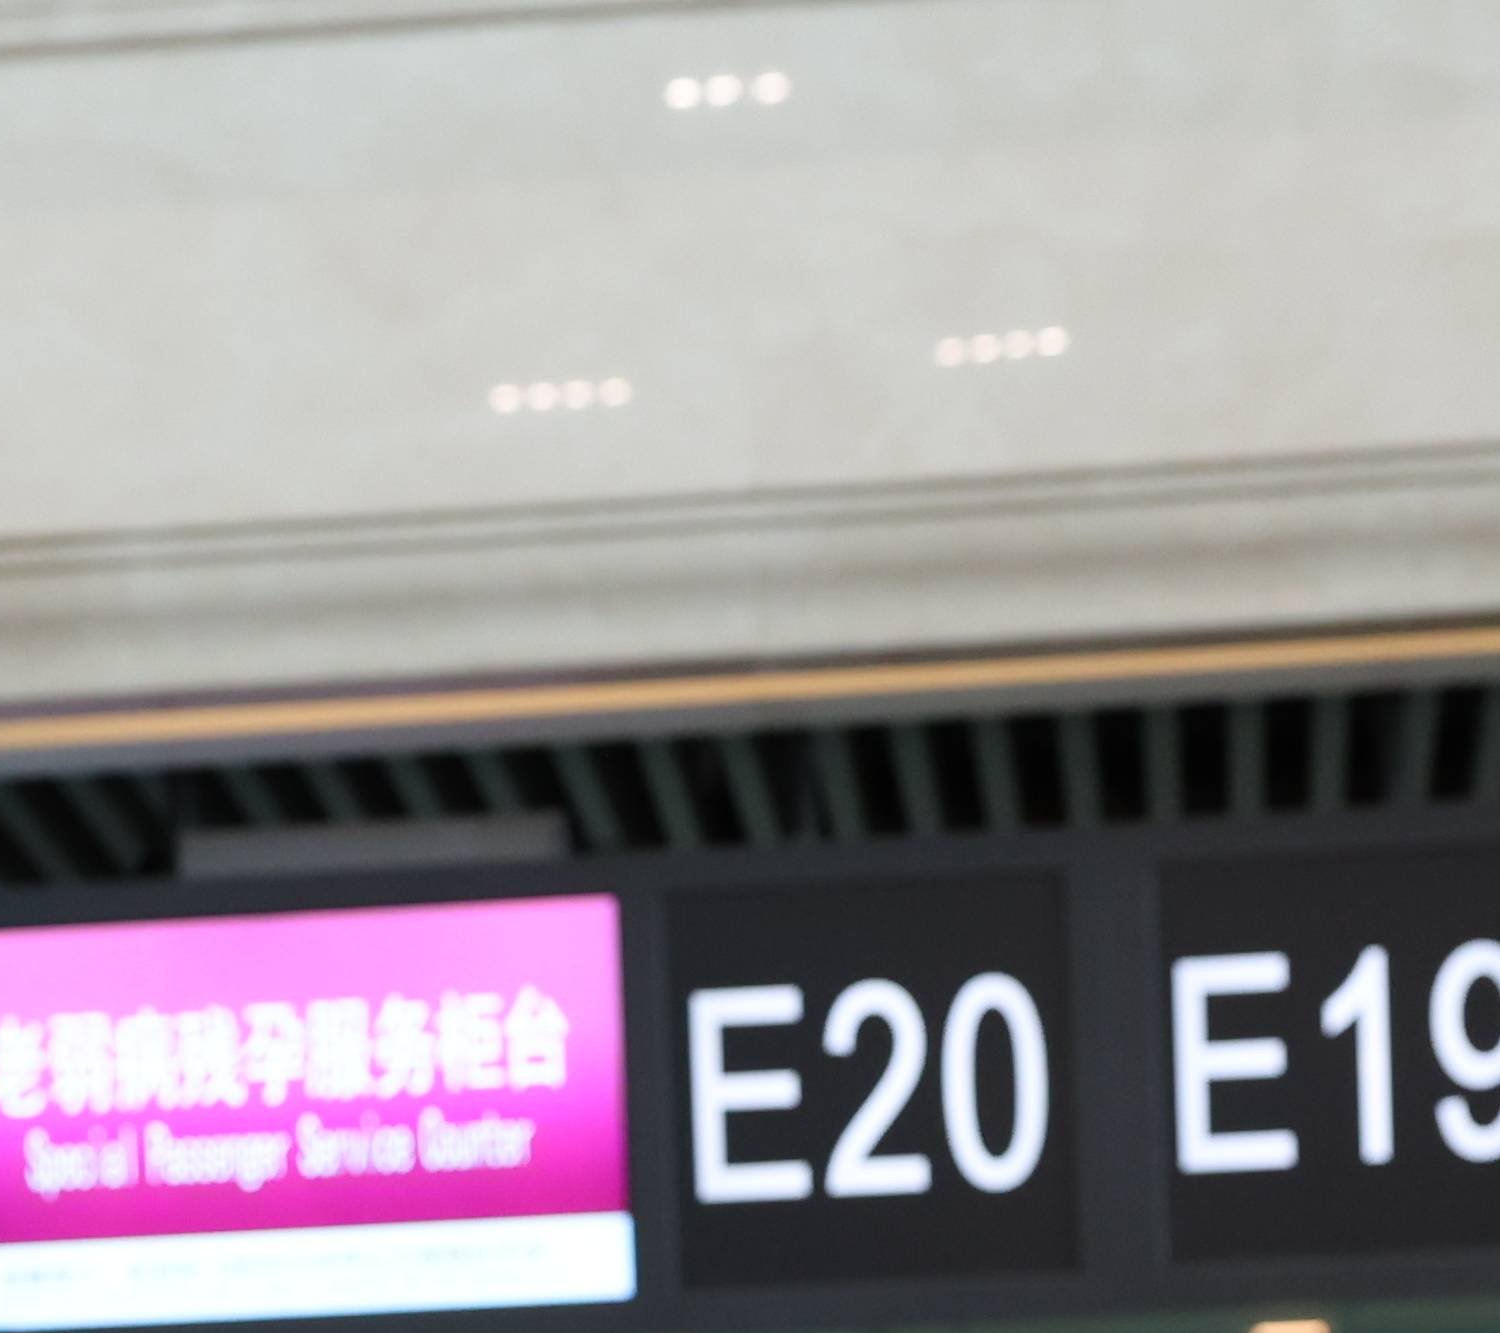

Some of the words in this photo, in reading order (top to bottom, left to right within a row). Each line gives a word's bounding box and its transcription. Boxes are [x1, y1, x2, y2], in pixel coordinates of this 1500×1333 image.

[24, 1126, 139, 1201] Special
[143, 1117, 292, 1194] Passenger
[296, 1111, 416, 1180] Service
[417, 1104, 537, 1172] Counter
[688, 971, 1049, 1203] E20
